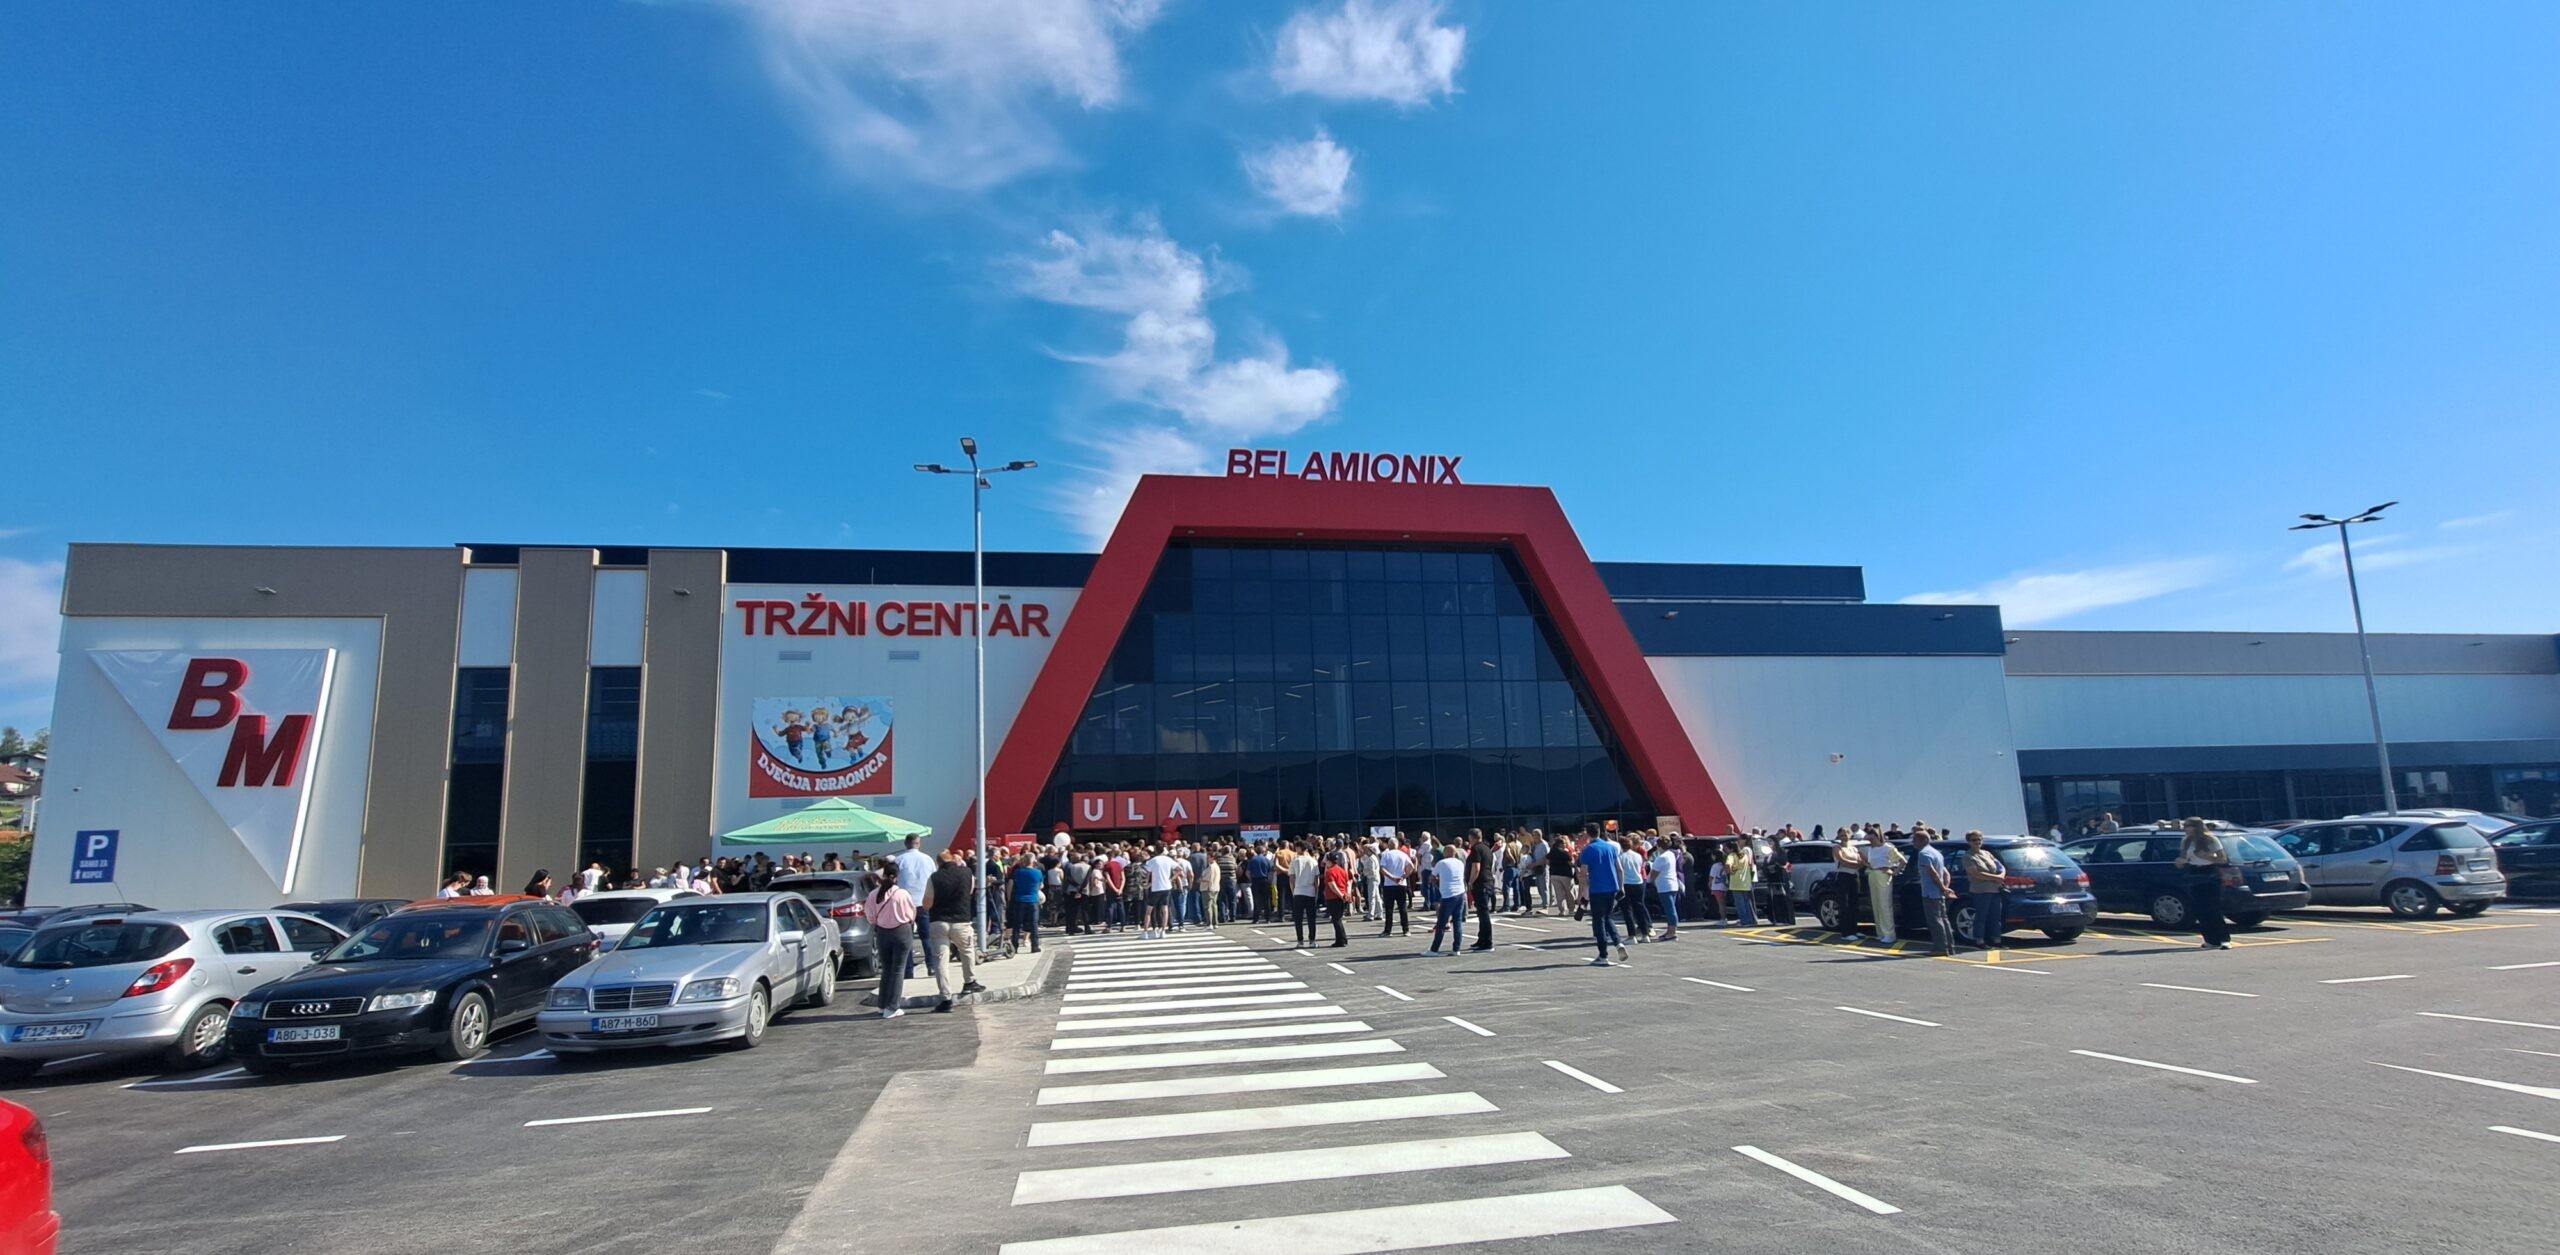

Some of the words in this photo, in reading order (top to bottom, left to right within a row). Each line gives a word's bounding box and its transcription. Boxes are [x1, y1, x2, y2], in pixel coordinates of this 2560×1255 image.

[1226, 448, 1463, 485] BELAMIONIX
[735, 592, 867, 636] TRŽNI
[875, 601, 1051, 637] CENTAR
[757, 752, 812, 792] DJEČIJA
[814, 752, 888, 792] IGRAONICA
[1083, 794, 1229, 822] ULAZ
[87, 834, 109, 858] P
[600, 1016, 657, 1030] A87-M-860
